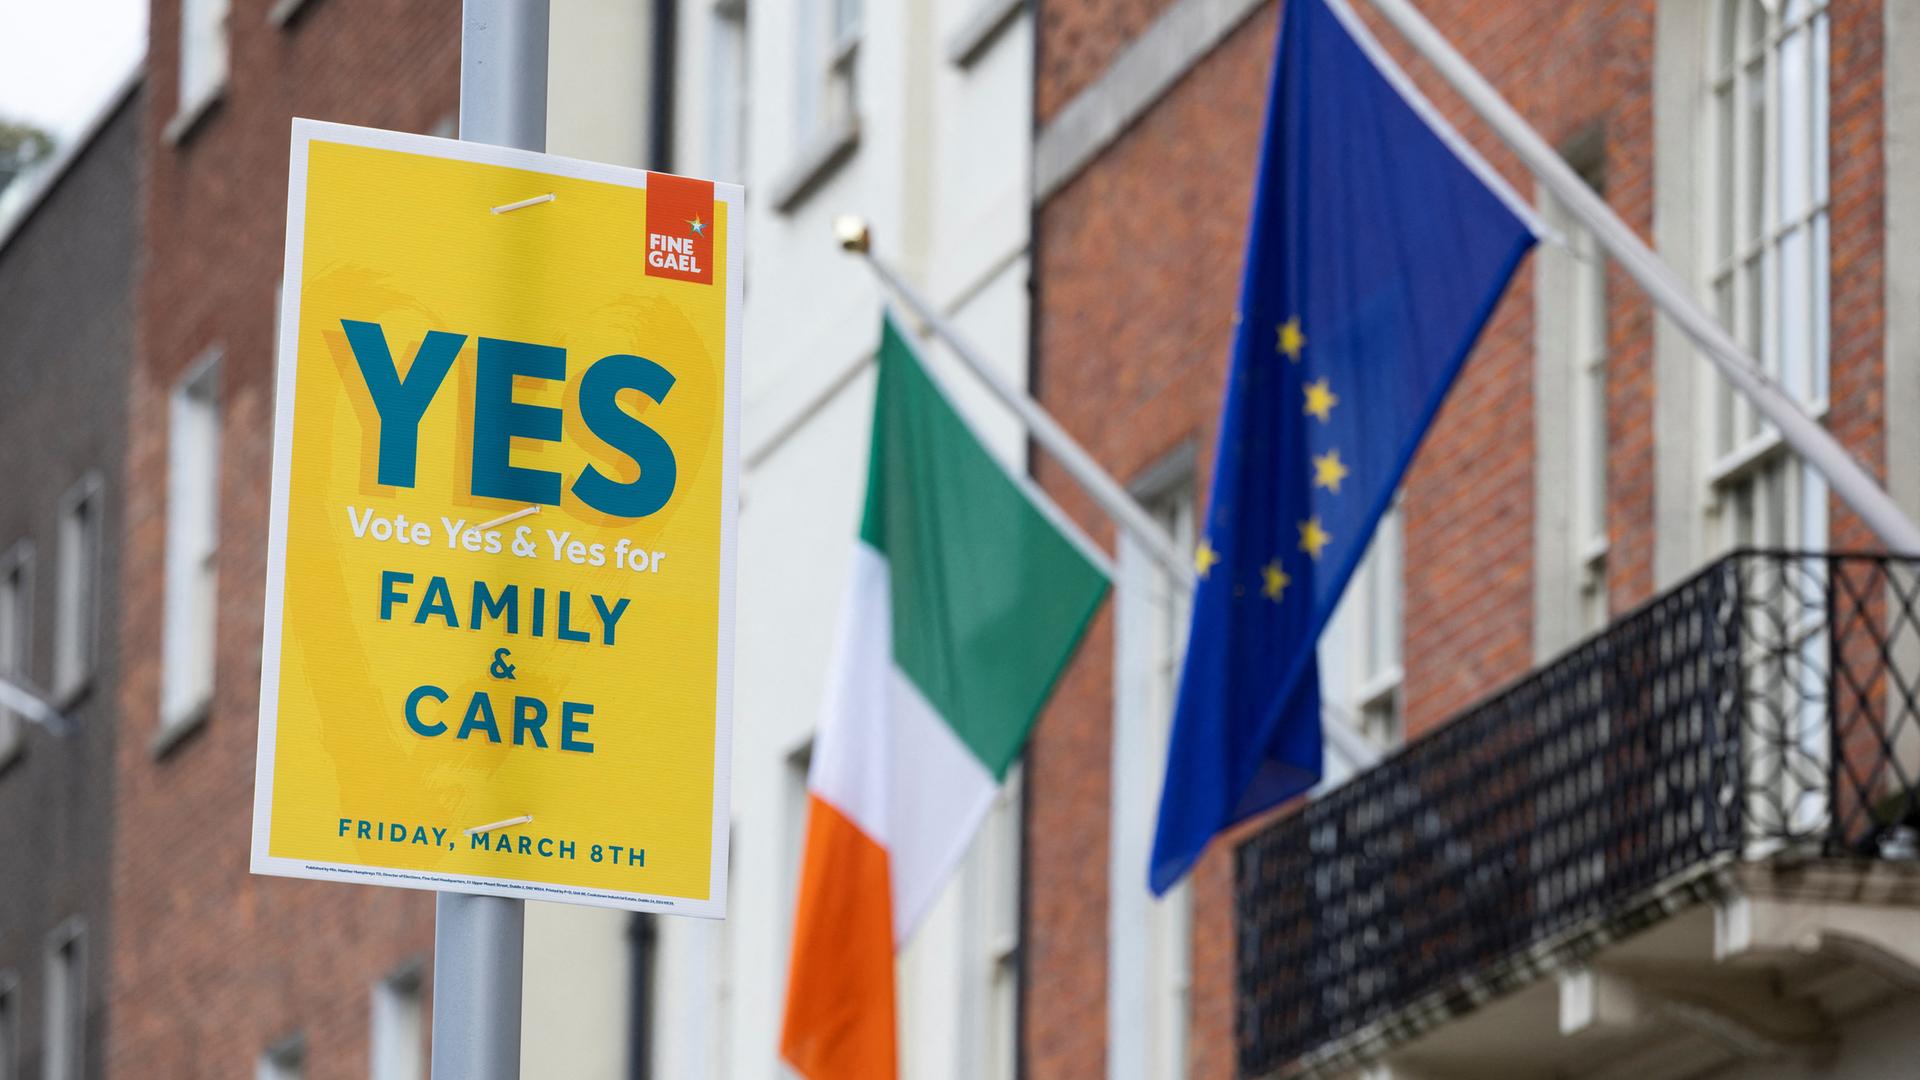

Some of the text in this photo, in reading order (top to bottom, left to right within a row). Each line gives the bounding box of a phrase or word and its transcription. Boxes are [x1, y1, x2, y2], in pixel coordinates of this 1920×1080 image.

[648, 250, 702, 274] GAEL
[649, 232, 694, 256] FINE
[341, 319, 677, 518] YES
[347, 506, 667, 574] Vote Yes & Yes for
[380, 570, 631, 646] FAMILY
[490, 647, 515, 679] &
[405, 685, 594, 753] CARE
[339, 818, 646, 867] FRIDAY, MARCH 8TH
